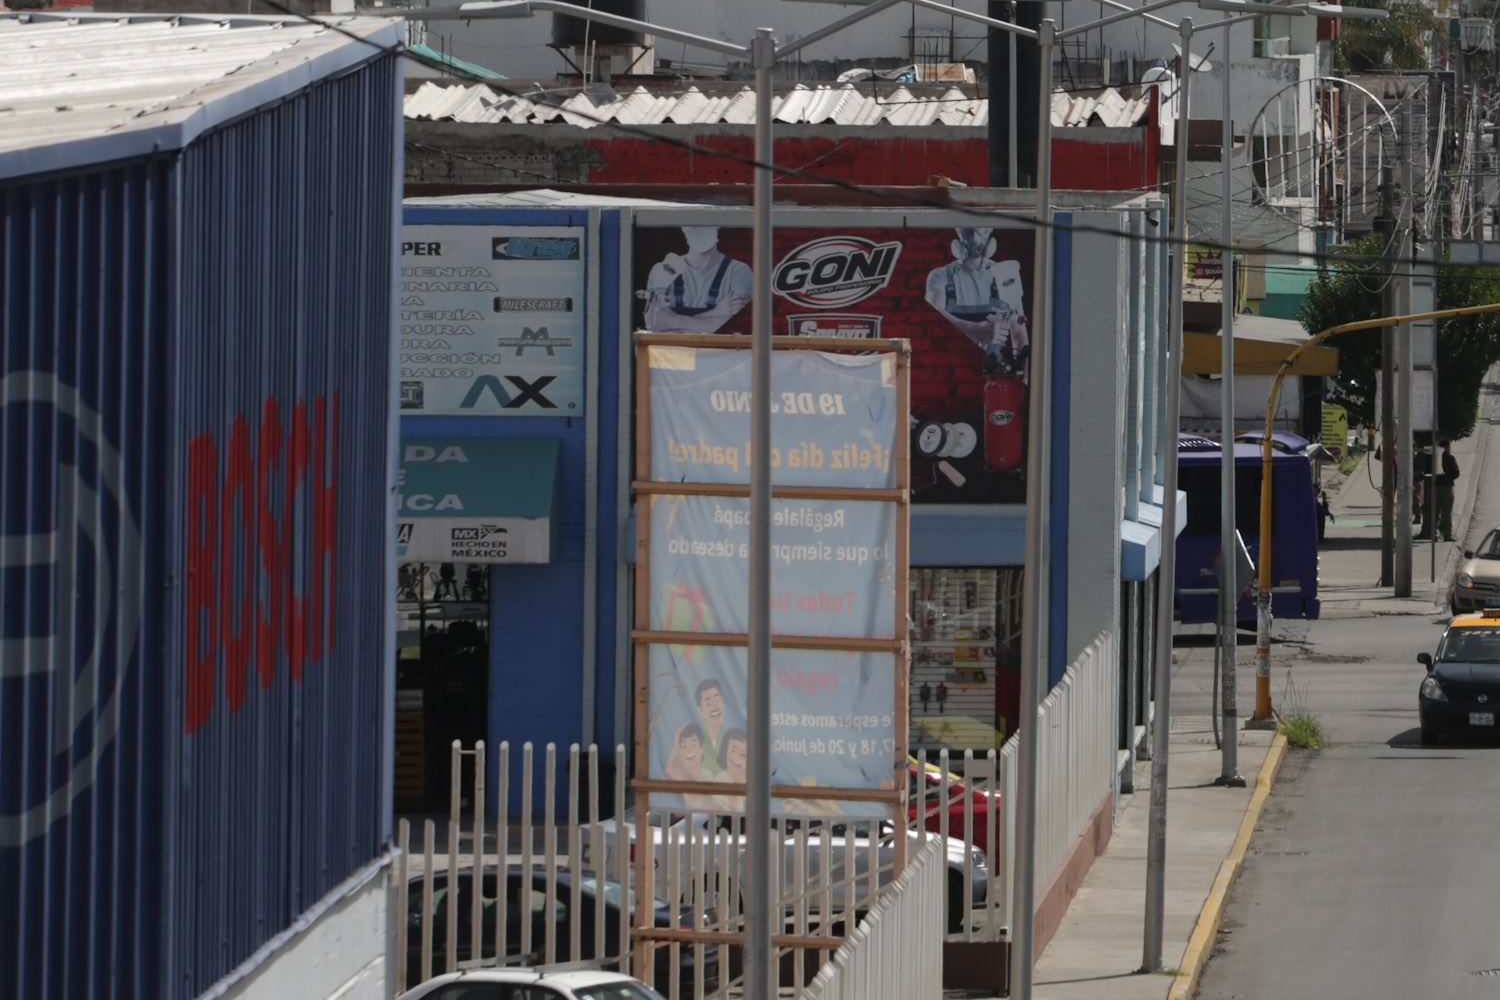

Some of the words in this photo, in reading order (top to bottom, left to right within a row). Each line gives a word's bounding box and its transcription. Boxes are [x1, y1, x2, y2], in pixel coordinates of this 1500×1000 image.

[400, 266, 492, 277] IENTA
[776, 247, 898, 292] GONI
[502, 299, 567, 311] MILESCRAFT
[454, 529, 478, 539] MX
[492, 540, 507, 548] EN
[452, 548, 507, 557] MÉXICO
[185, 388, 339, 737] BOSCH
